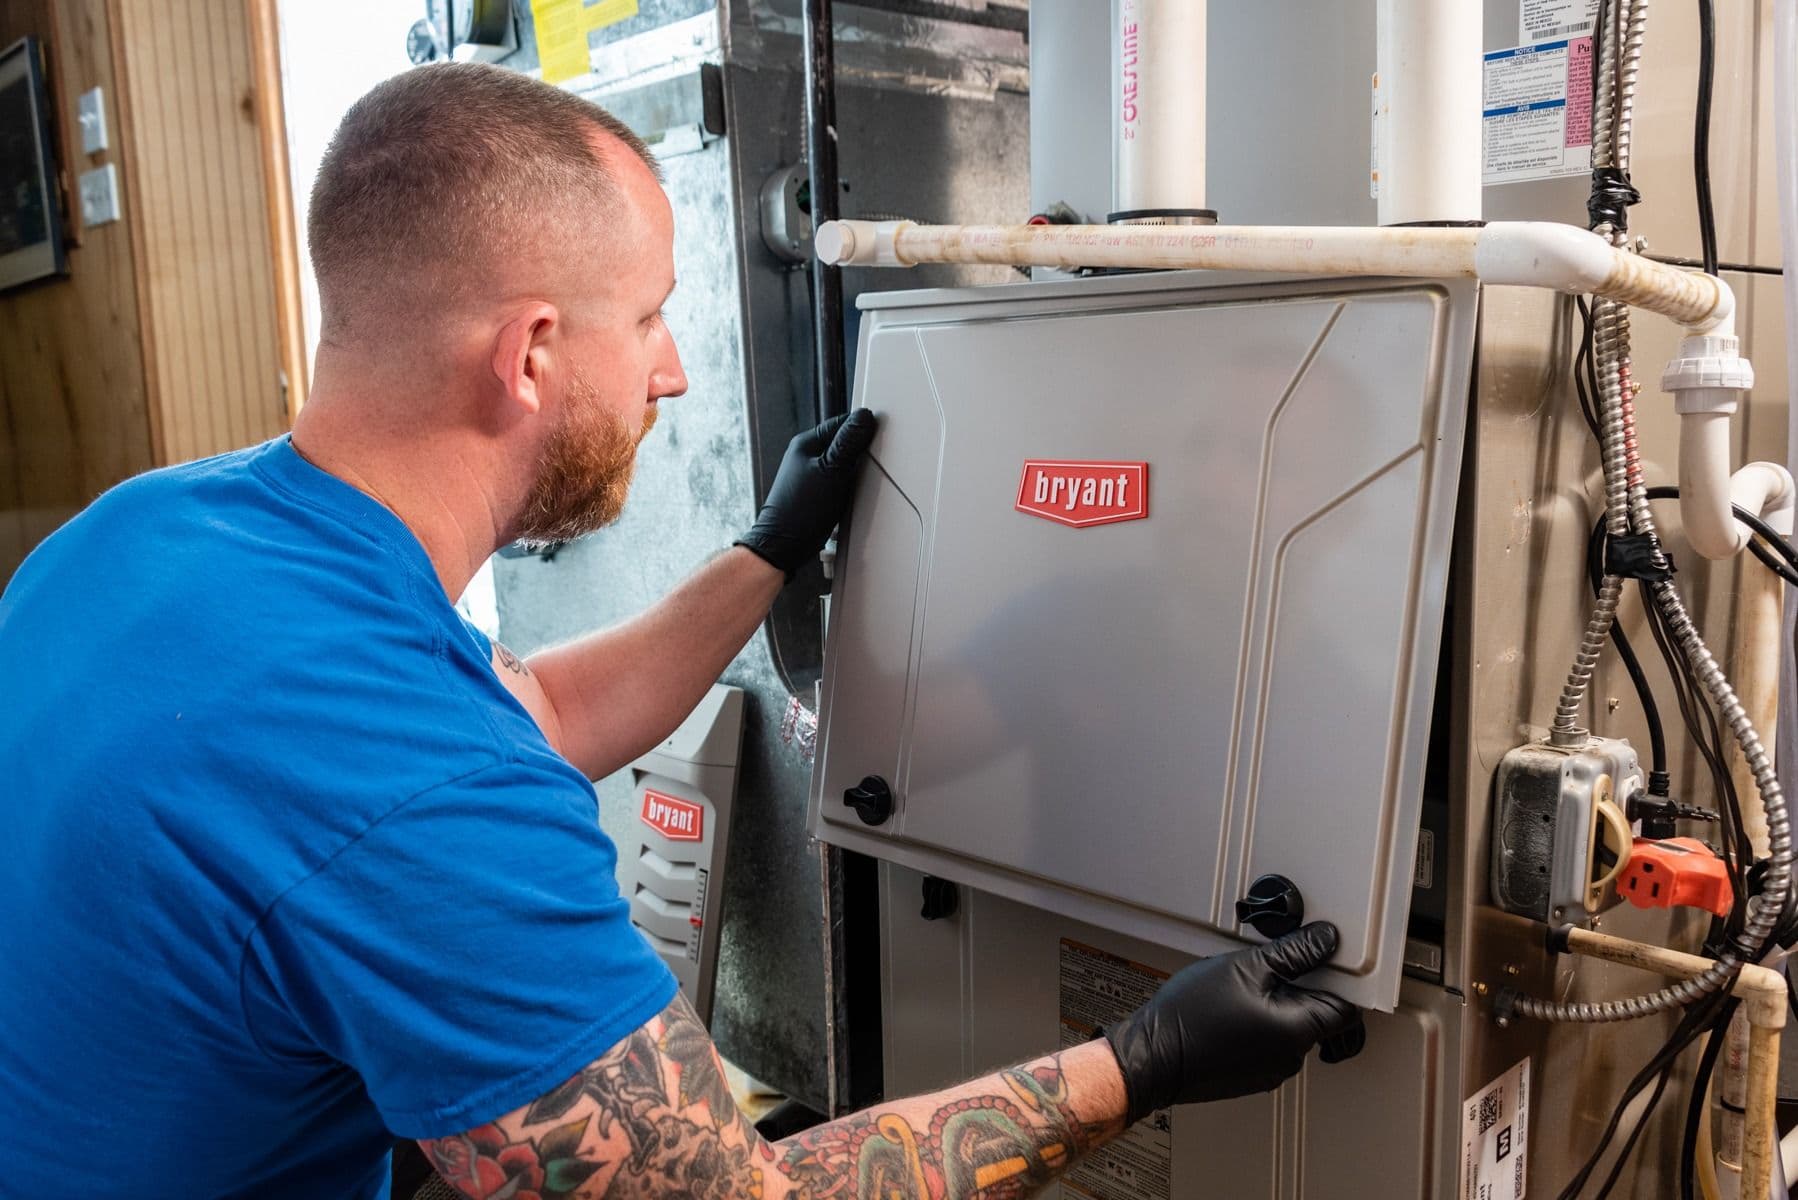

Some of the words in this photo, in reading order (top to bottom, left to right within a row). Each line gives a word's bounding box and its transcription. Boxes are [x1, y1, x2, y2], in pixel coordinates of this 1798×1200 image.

[1514, 46, 1536, 55] NOTICE
[1034, 470, 1128, 511] bryant
[648, 797, 694, 833] bryant
